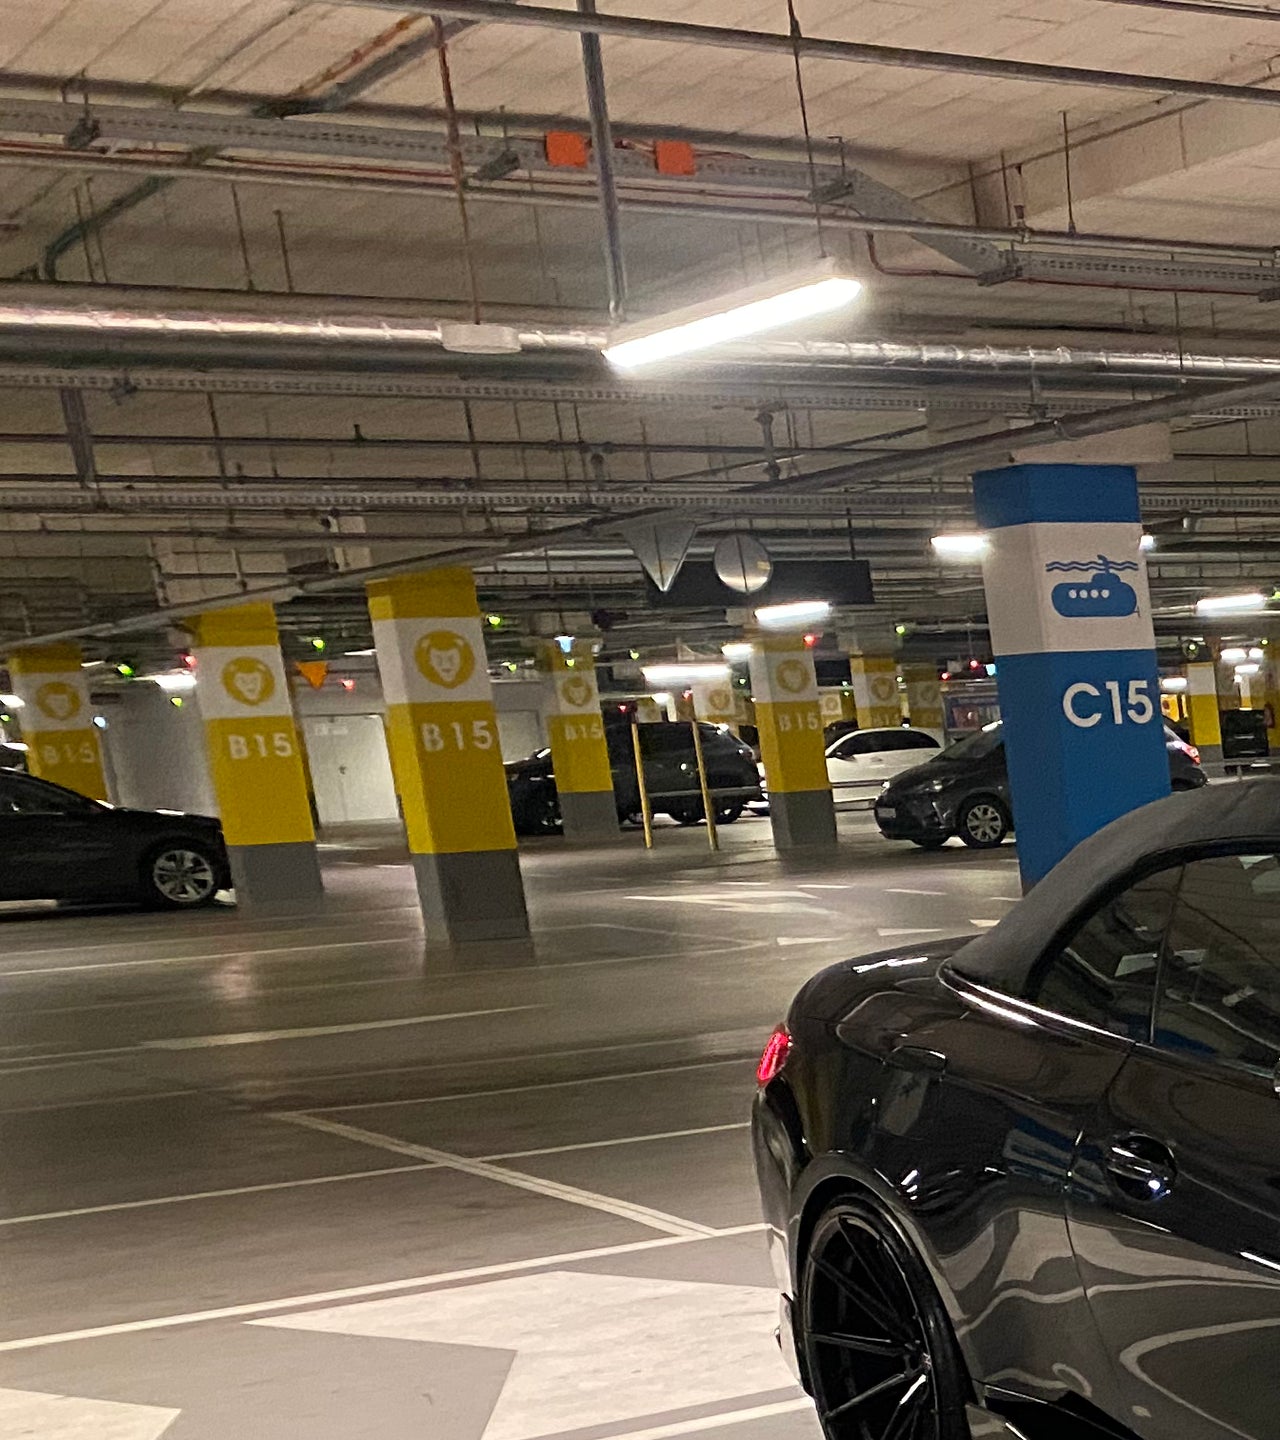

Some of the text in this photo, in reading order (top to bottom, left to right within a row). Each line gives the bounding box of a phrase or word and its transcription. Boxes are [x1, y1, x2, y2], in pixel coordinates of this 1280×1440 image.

[1062, 680, 1153, 728] C15
[563, 723, 604, 741] B15
[778, 712, 819, 732] B15
[228, 732, 293, 760] B15
[421, 719, 494, 752] B15
[43, 742, 96, 765] B15
